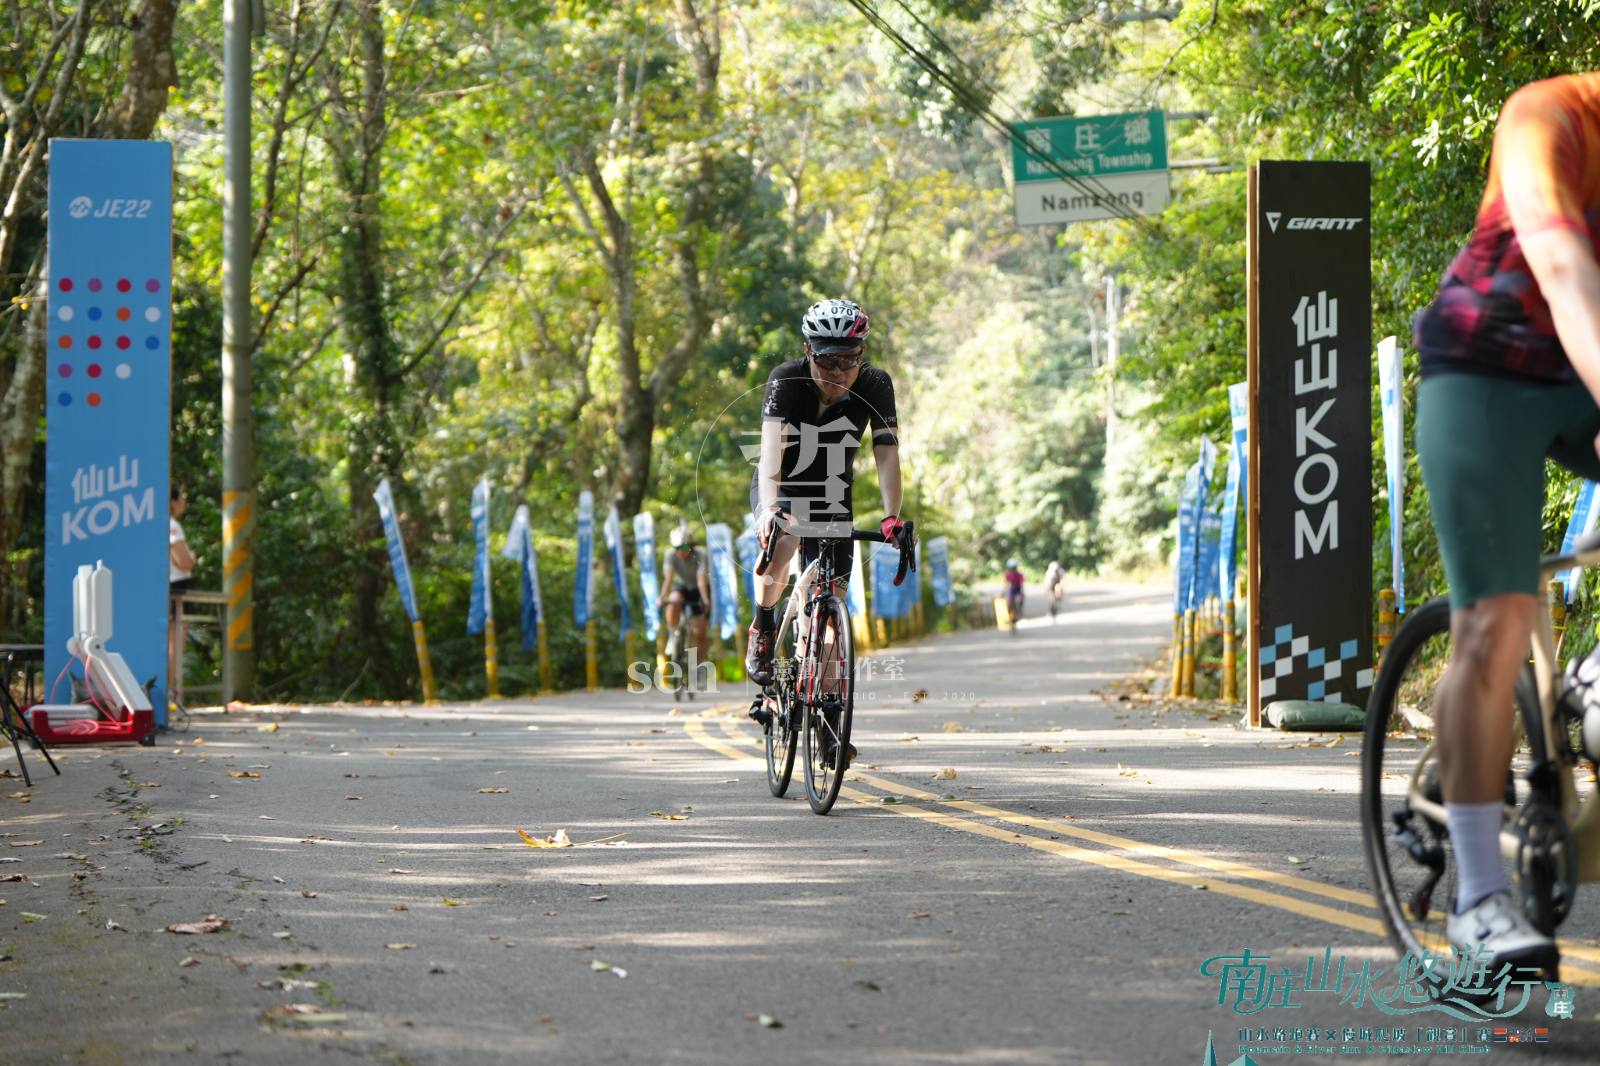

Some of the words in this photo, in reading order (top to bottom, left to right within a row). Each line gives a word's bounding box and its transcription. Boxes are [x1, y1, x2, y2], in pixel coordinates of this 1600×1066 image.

[1098, 150, 1153, 168] Township
[94, 199, 152, 218] JE22
[1286, 217, 1363, 230] GIANT
[70, 454, 138, 505] 仙山
[62, 487, 154, 545] KOM
